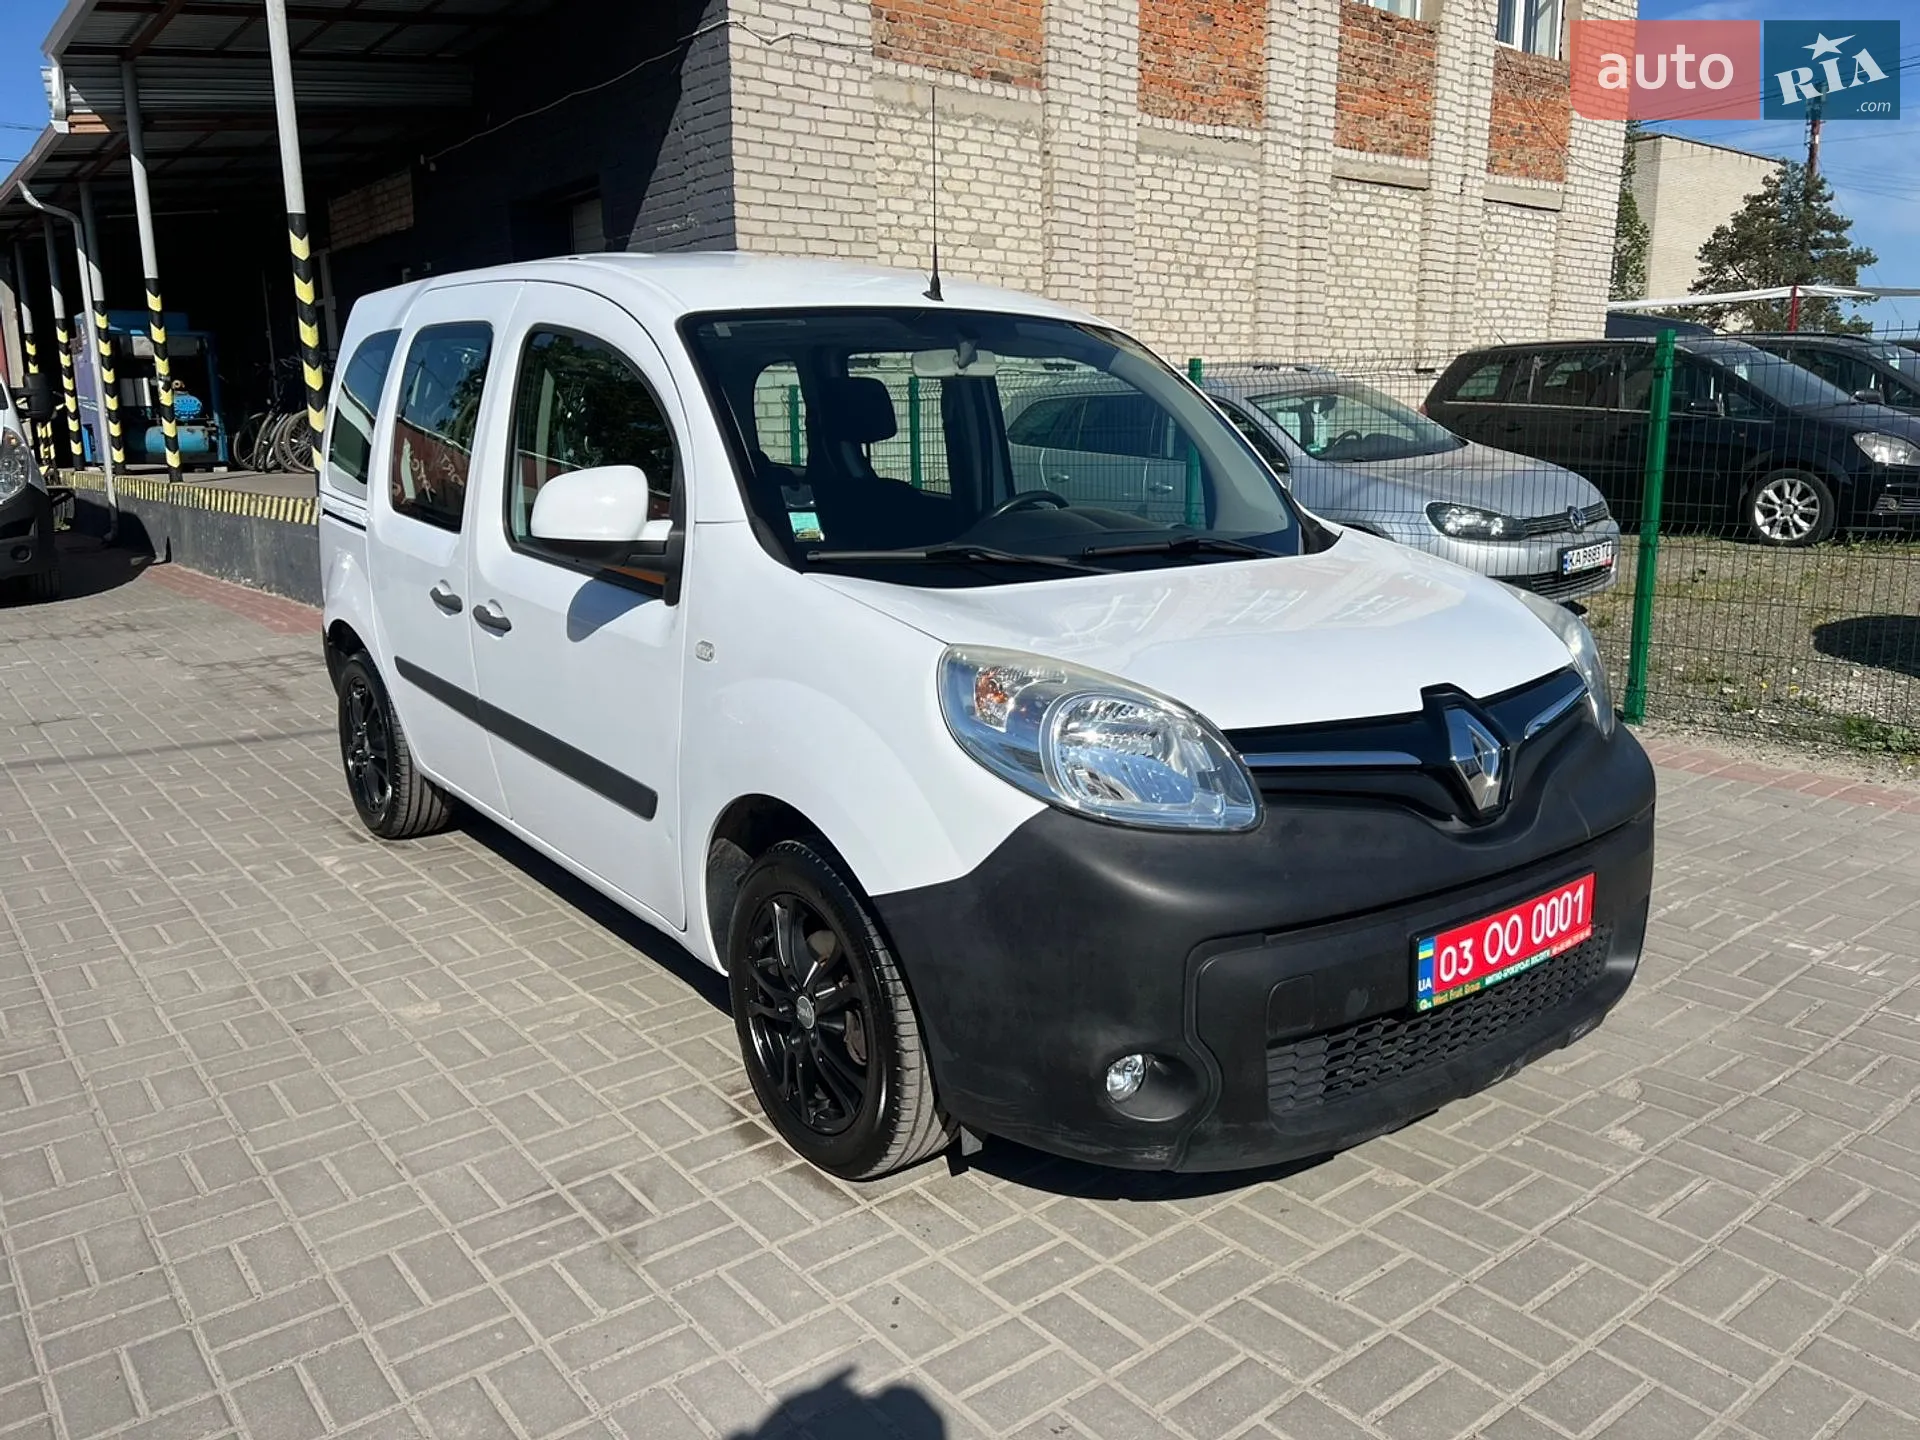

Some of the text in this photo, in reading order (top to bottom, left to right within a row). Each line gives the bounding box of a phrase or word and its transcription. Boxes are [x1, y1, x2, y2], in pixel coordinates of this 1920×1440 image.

[1440, 938, 1474, 982] 03
[1532, 884, 1584, 945] 0001
[1418, 978, 1432, 992] UA
